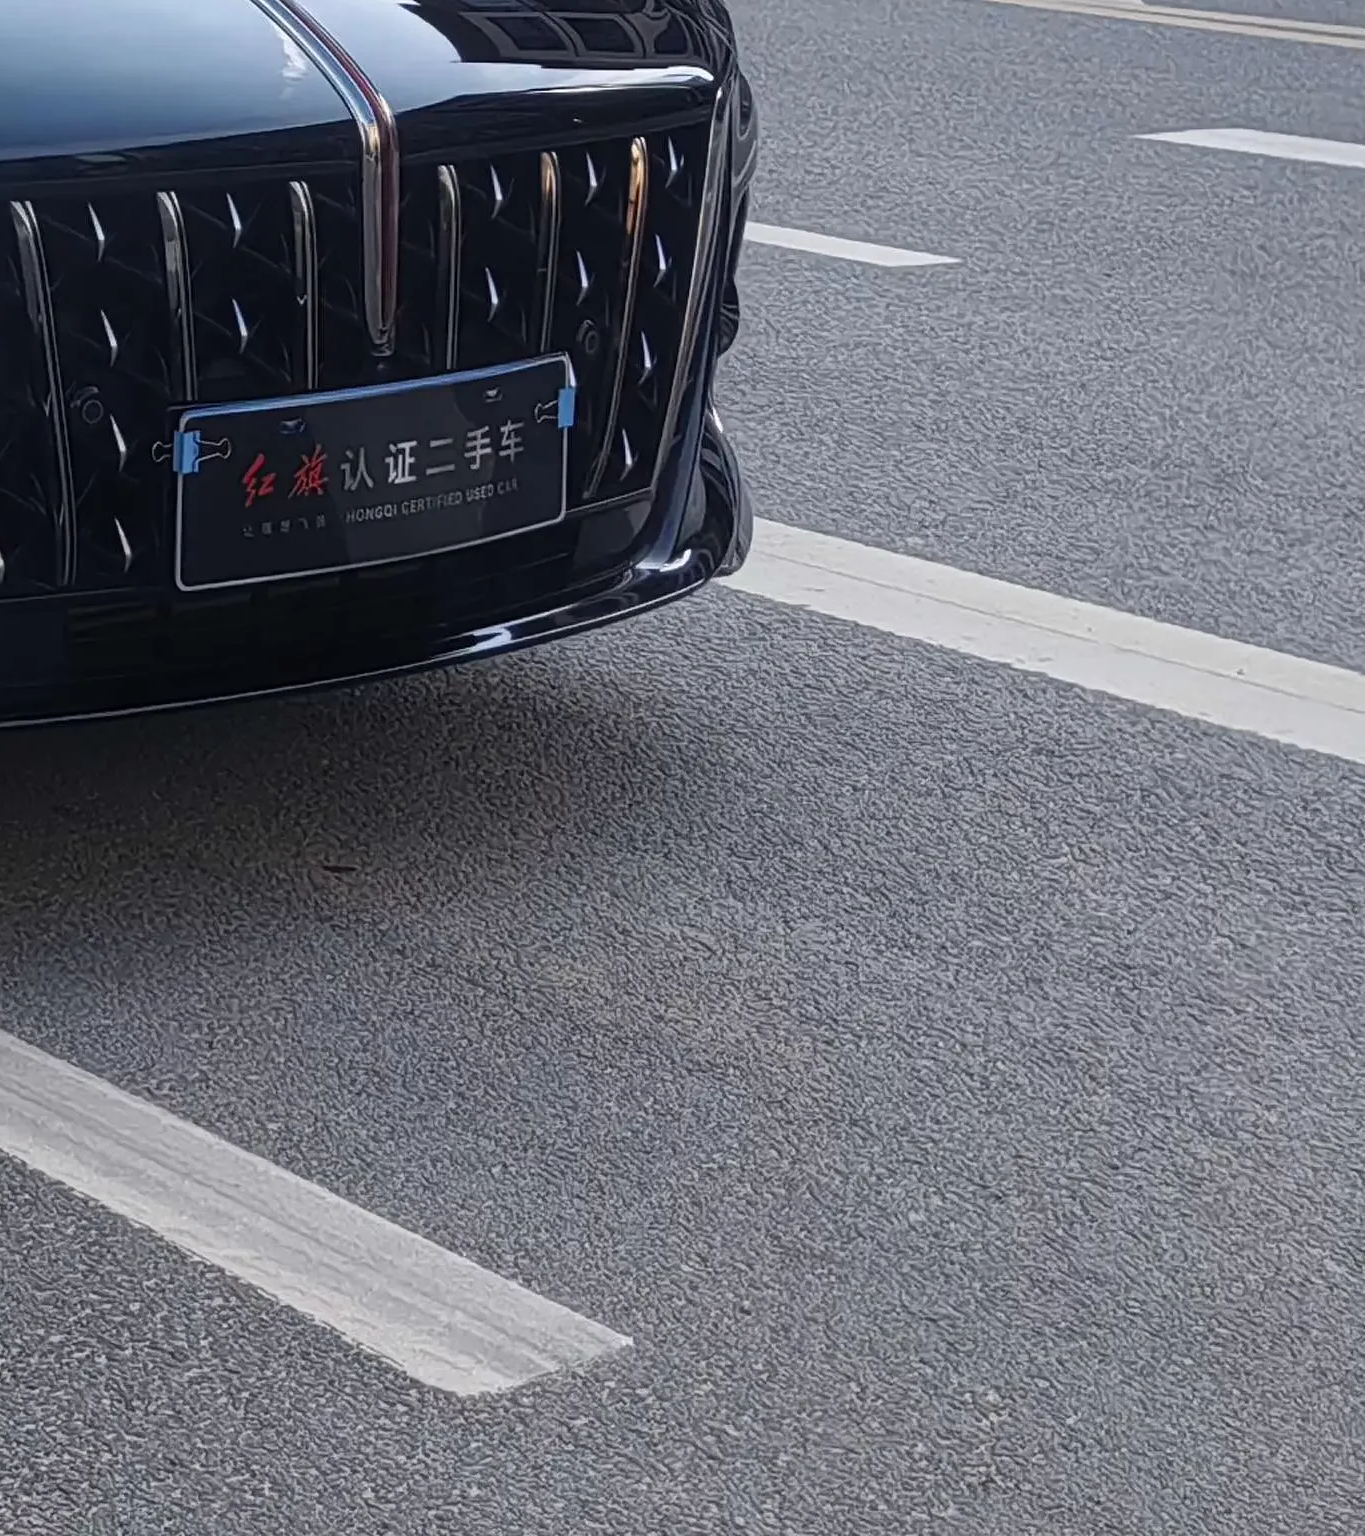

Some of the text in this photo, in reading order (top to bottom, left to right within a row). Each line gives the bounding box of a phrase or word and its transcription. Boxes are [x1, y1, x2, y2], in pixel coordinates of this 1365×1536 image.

[242, 419, 525, 507] 红旗认证二手车
[346, 504, 398, 524] HONGQI
[466, 484, 494, 502] USED
